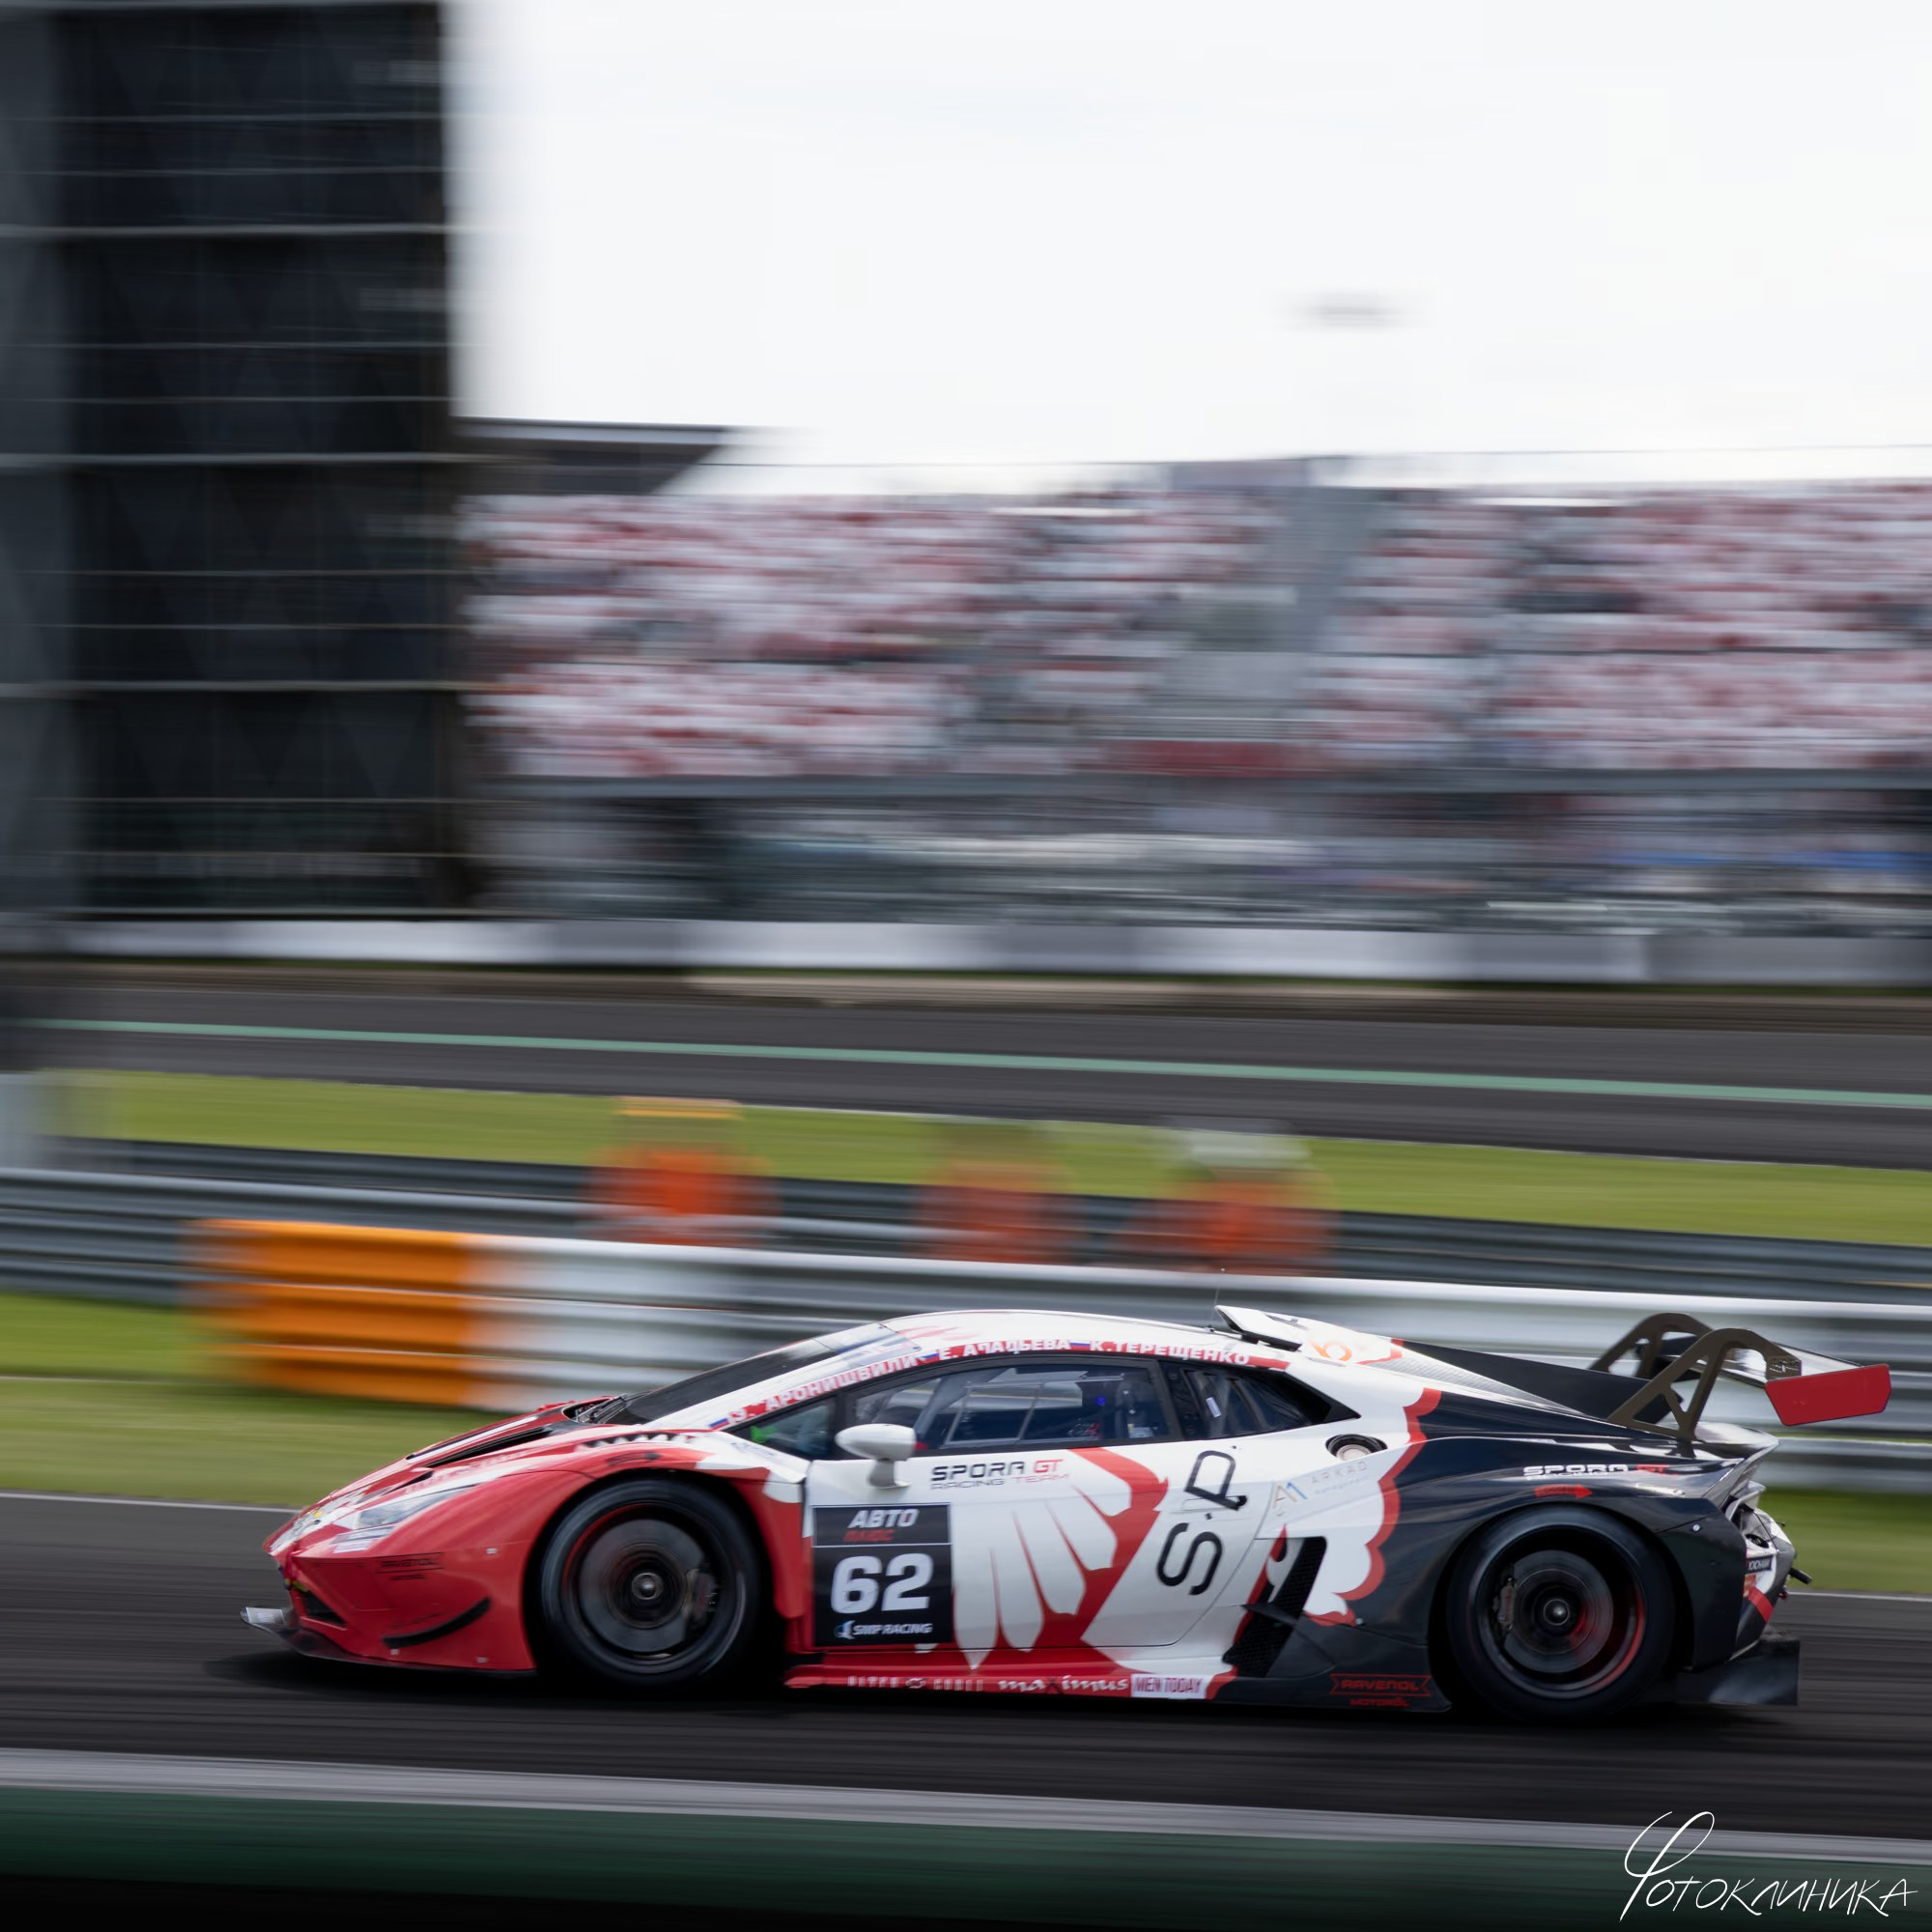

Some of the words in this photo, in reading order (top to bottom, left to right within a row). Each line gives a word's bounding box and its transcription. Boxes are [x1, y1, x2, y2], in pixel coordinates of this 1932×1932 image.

[764, 1354, 918, 1411] АРОНИШВИЛИ
[930, 1461, 1025, 1482] SPORA
[1034, 1459, 1064, 1473] GT
[1522, 1463, 1629, 1476] SPORA
[930, 1478, 1005, 1490] RACING
[1012, 1473, 1070, 1484] TEAM
[847, 1508, 920, 1528] АВТО
[831, 1552, 934, 1614] 62
[852, 1624, 881, 1635] SMP
[881, 1623, 933, 1634] RACING
[1164, 1677, 1204, 1693] TODAY
